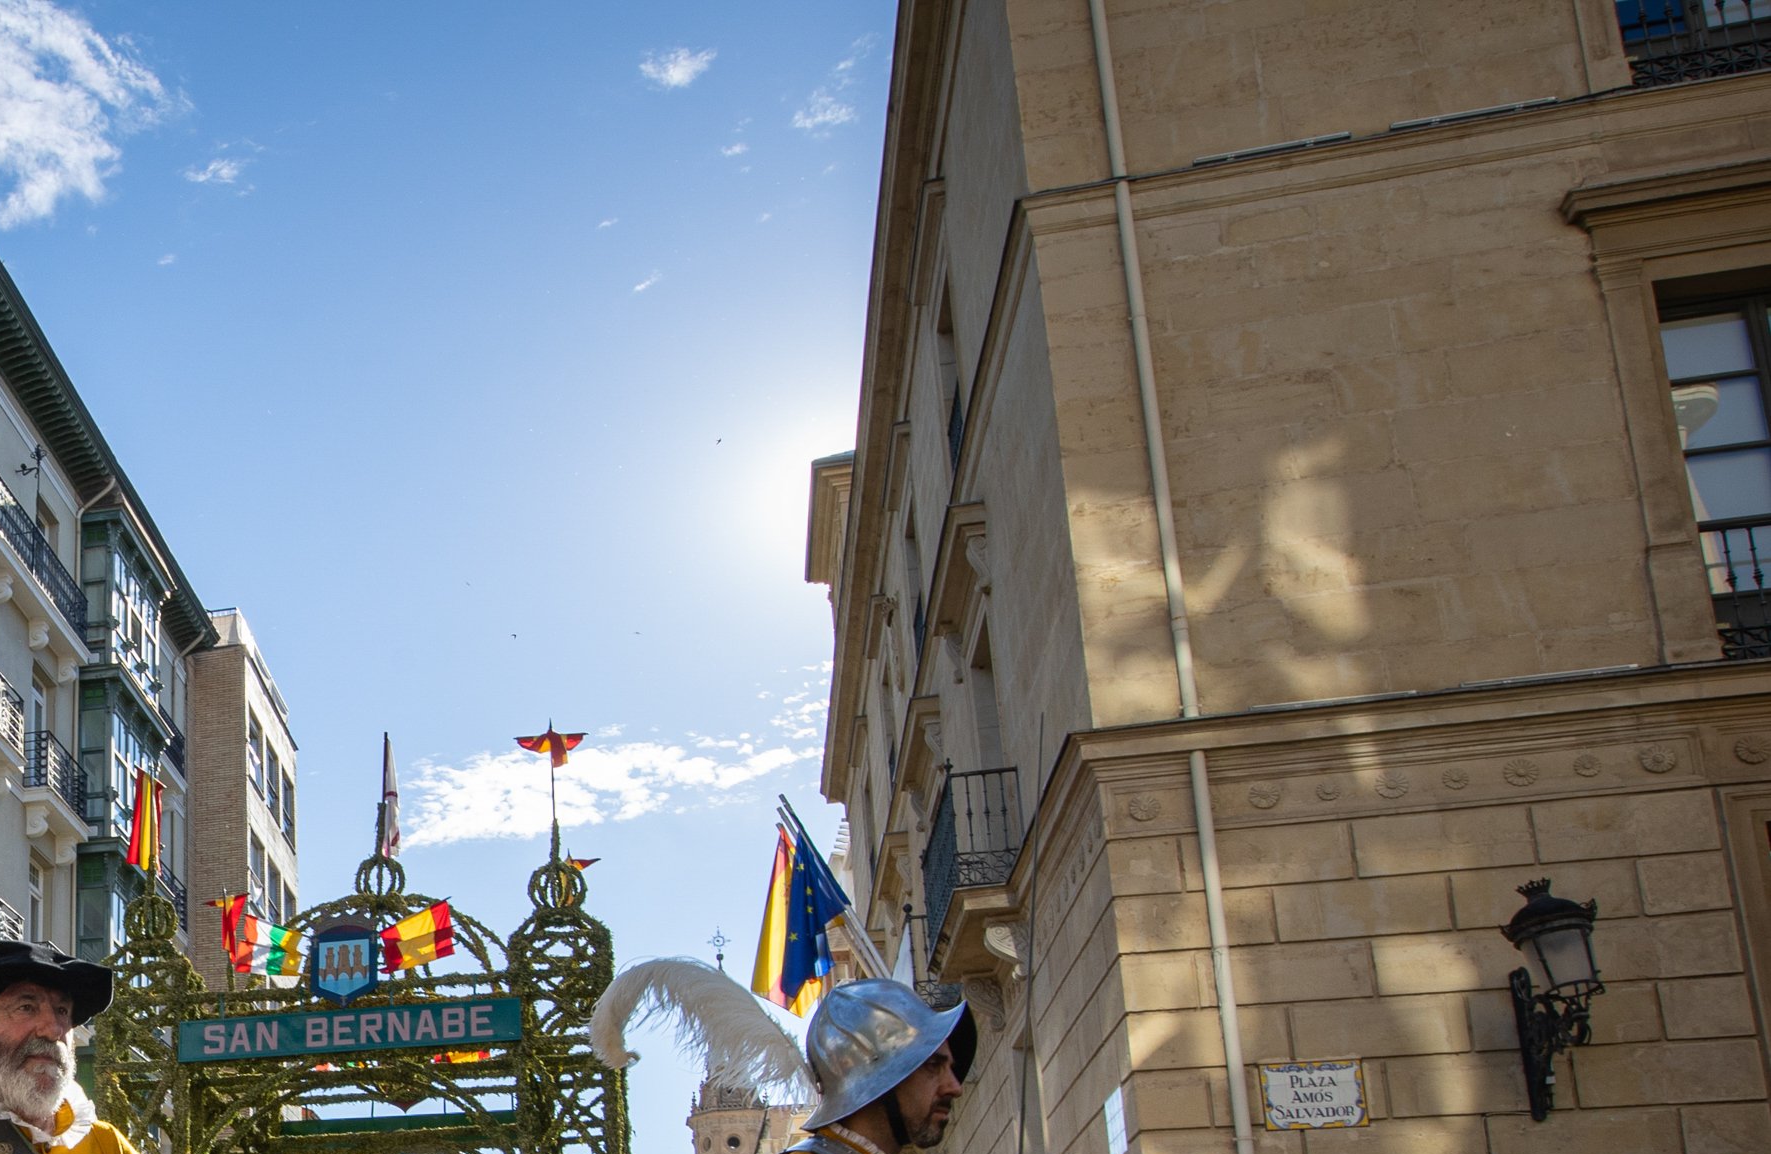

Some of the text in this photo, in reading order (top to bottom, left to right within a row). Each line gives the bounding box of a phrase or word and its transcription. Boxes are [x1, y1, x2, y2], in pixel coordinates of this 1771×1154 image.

[203, 1005, 494, 1055] SAN BERNABE
[1289, 1074, 1338, 1089] PLAZA
[1291, 1088, 1334, 1103] AMÓS
[1274, 1104, 1355, 1120] SALVADOR
